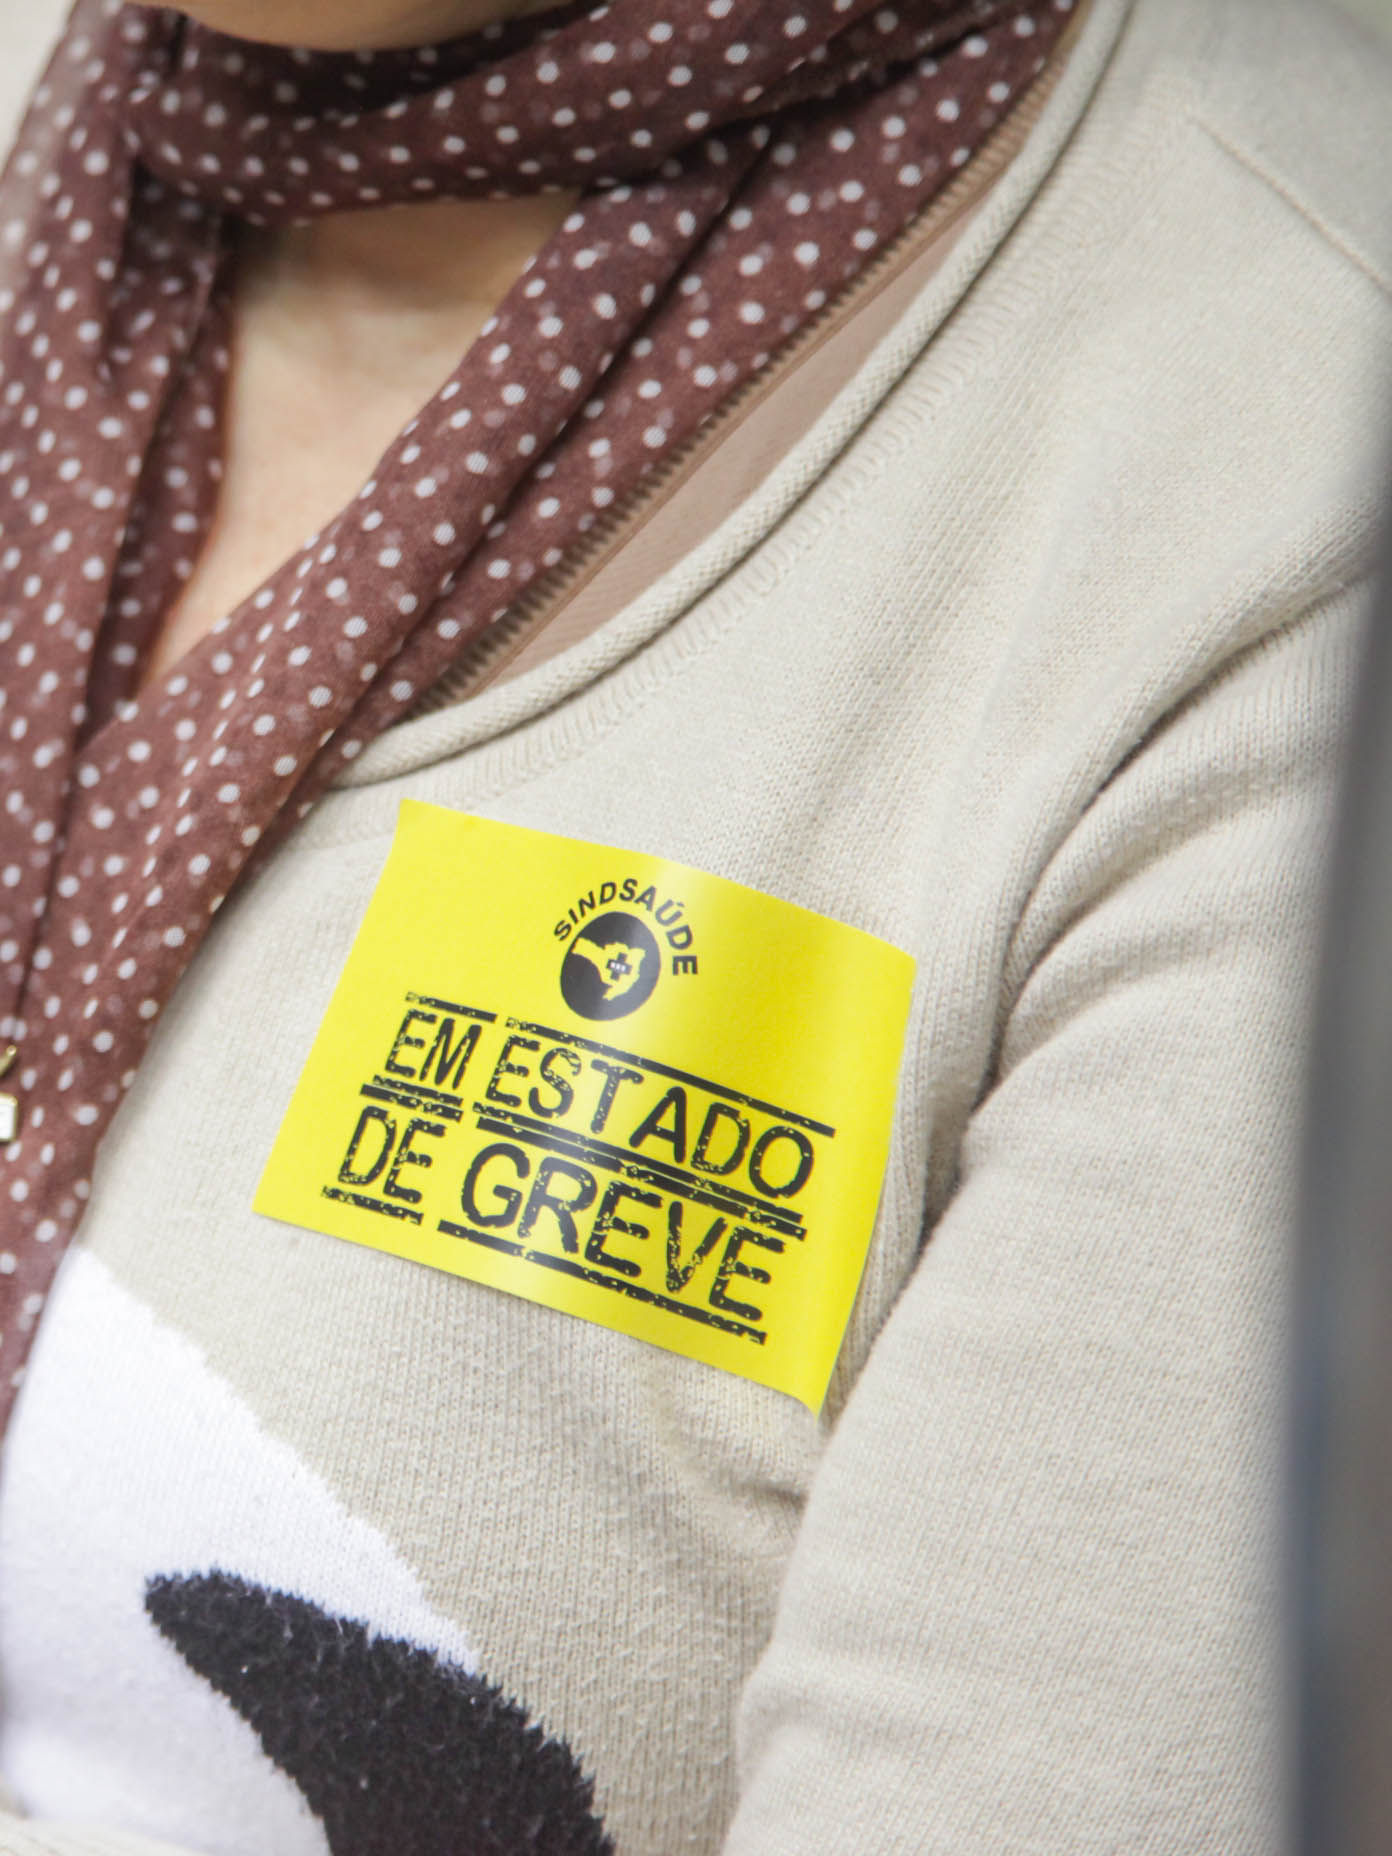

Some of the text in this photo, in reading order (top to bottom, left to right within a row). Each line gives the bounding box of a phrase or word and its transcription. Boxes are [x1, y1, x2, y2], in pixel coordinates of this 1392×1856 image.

[553, 877, 699, 977] SINDSAÚDE
[384, 1008, 815, 1200] EM ESTADO
[337, 1105, 789, 1322] DE GREVE
